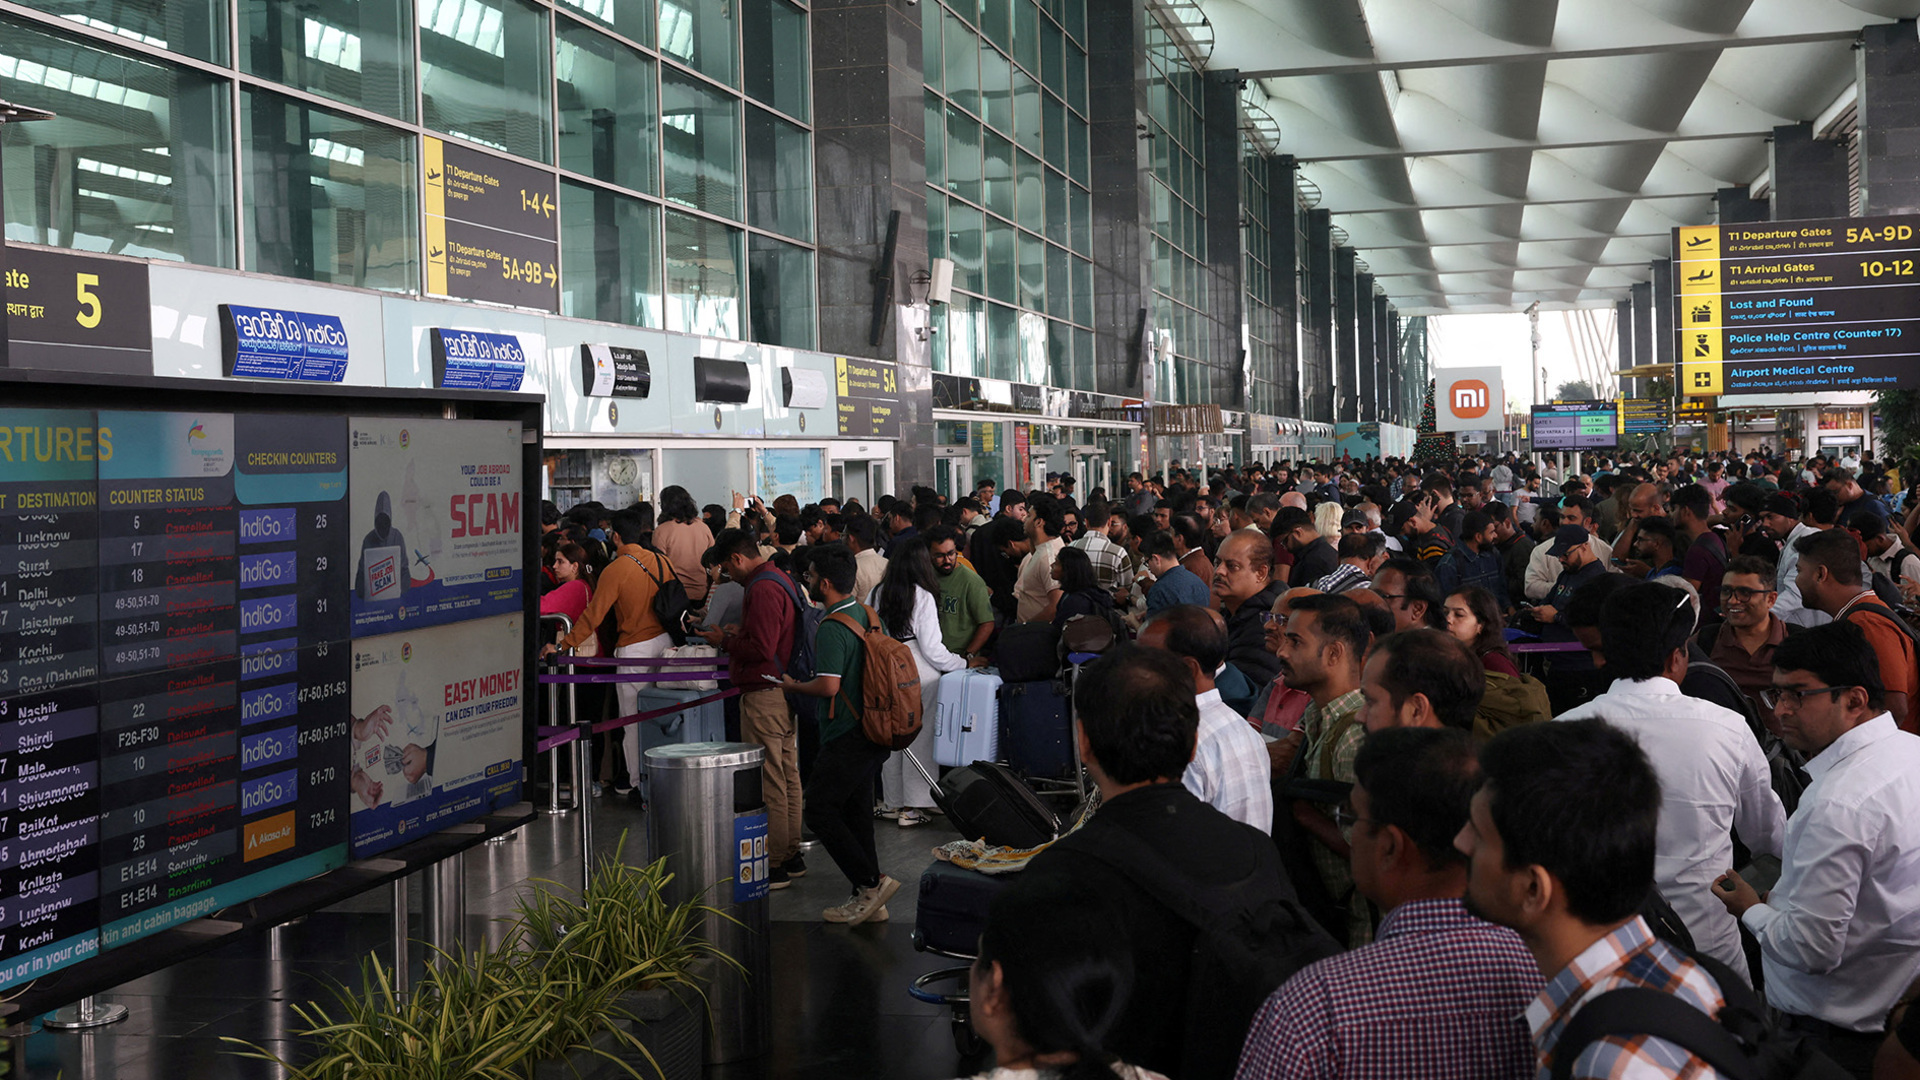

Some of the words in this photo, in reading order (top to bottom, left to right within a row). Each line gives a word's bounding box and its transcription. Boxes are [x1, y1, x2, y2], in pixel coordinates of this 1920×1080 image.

[520, 189, 540, 214] 1-4
[1728, 232, 1740, 241] T1
[1743, 229, 1798, 241] Departure
[1801, 227, 1832, 238] Gates
[1846, 225, 1913, 244] 5A-9D
[502, 256, 542, 284] 5A-9B
[1730, 266, 1741, 275] T1
[1744, 264, 1781, 275] Arrival
[1783, 263, 1815, 273] Gates
[1860, 259, 1914, 277] 10-12
[76, 272, 102, 328] 5
[1729, 300, 1753, 309] Lost
[1756, 298, 1776, 308] and
[1779, 297, 1814, 308] Found
[302, 322, 346, 346] IndiGo
[1729, 334, 1762, 343] Police
[1765, 332, 1791, 343] Help
[1793, 331, 1830, 341] Centre
[1833, 329, 1883, 340] (Counter
[1886, 327, 1902, 338] 17)
[493, 342, 523, 361] IndiGo
[883, 368, 897, 393] 5A
[1730, 367, 1770, 378] Airport
[1772, 365, 1814, 376] Medical
[1817, 365, 1855, 374] Centre
[610, 408, 616, 420] 3
[248, 453, 289, 466] CHECKIN
[290, 452, 337, 465] COUNTERS
[461, 465, 476, 475] YOUR
[477, 465, 487, 475] JOB
[488, 464, 510, 475] ABROAD
[470, 477, 488, 487] COULD
[489, 477, 496, 486] BE
[17, 491, 97, 508] DESTINATION
[109, 489, 163, 506] COUNTER
[165, 487, 205, 503] STATUS
[134, 515, 140, 529] 5
[450, 492, 519, 538] SCAM
[240, 515, 281, 538] IndiGo
[131, 542, 143, 556] 17
[241, 558, 282, 583] IndiGo
[316, 557, 327, 571] 29
[131, 568, 144, 583] 18
[241, 600, 282, 628] IndiGo
[317, 599, 327, 613] 31
[317, 642, 328, 657] 33
[241, 645, 282, 675] IndiGo
[444, 679, 477, 706] EASY
[479, 669, 521, 698] MONEY
[133, 703, 145, 719] 22
[241, 693, 282, 720] IndiGo
[445, 711, 458, 723] CAN
[459, 707, 474, 720] COST
[475, 701, 491, 715] YOUR
[491, 696, 518, 711] FREEDOM
[118, 726, 159, 748] F26-F30
[241, 738, 282, 764] IndiGo
[133, 756, 145, 772] 10
[310, 766, 335, 786] 51-70
[241, 782, 282, 810] IndiGo
[133, 809, 145, 825] 10
[310, 808, 335, 829] 73-74
[280, 826, 291, 840] Air
[133, 835, 145, 851] 25
[121, 858, 157, 882] E1-E14
[121, 884, 157, 909] E1-E14
[16, 962, 30, 977] or
[32, 957, 43, 972] in
[46, 946, 72, 970] your
[122, 919, 141, 938] and
[144, 909, 171, 930] cabin
[174, 895, 217, 920] baggage.
